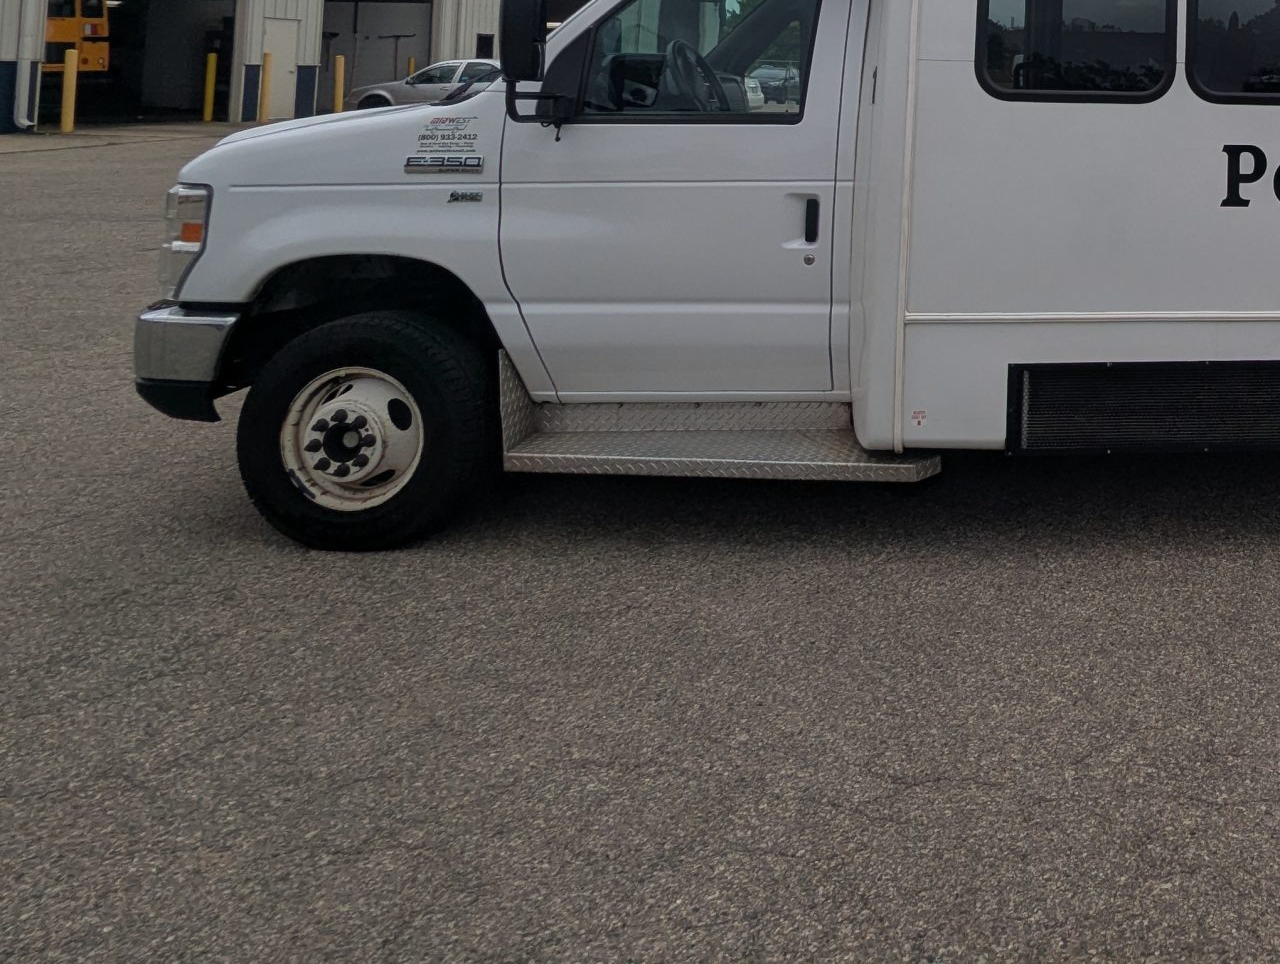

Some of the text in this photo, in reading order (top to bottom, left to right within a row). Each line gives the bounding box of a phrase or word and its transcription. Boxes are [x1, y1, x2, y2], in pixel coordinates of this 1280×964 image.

[417, 133, 478, 142] (800) 933-2412
[406, 157, 482, 167] E-350
